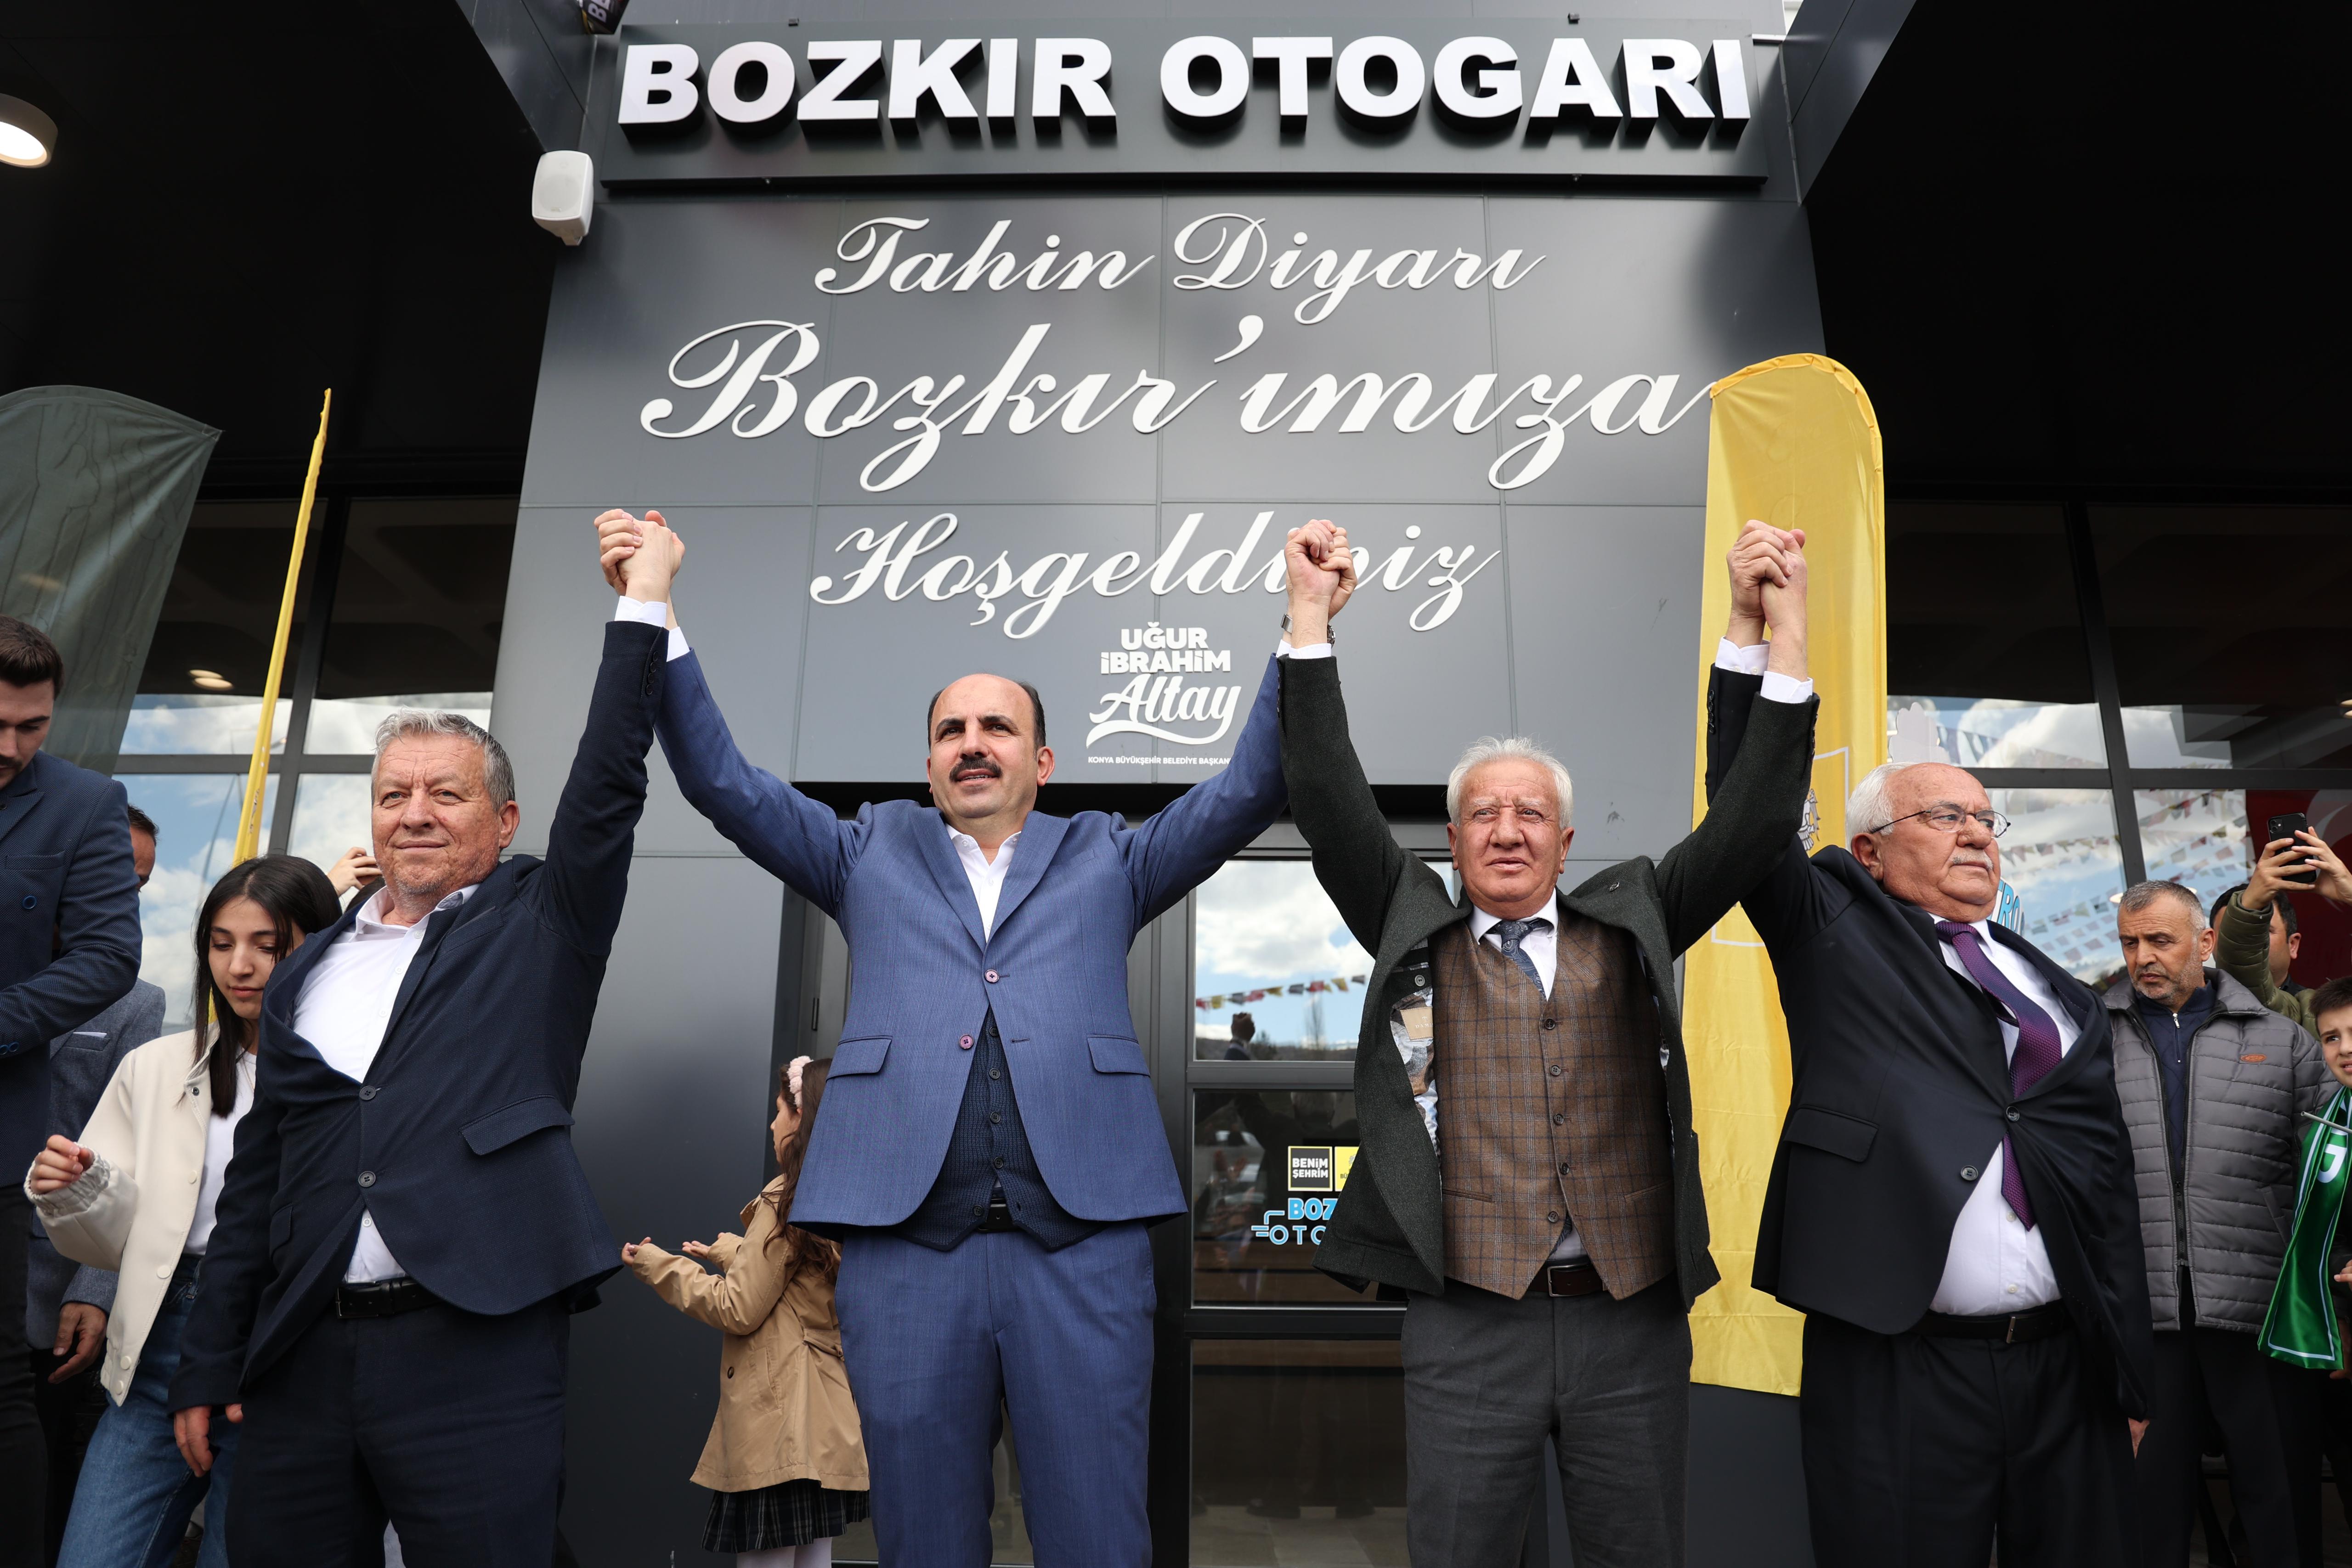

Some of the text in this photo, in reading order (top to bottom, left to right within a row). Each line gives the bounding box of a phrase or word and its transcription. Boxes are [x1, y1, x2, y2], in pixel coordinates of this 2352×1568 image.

[618, 36, 1751, 123] BOZKIR OTOGARI
[814, 213, 1547, 324] Tahin Diyarı
[1121, 621, 1209, 650] UĞUR
[1086, 673, 1242, 749] Altay
[1116, 756, 1161, 766] BÜYÜKŞEHİR
[1163, 756, 1198, 765] BELEDİYE
[1292, 1168, 1329, 1179] ŞEHRİM
